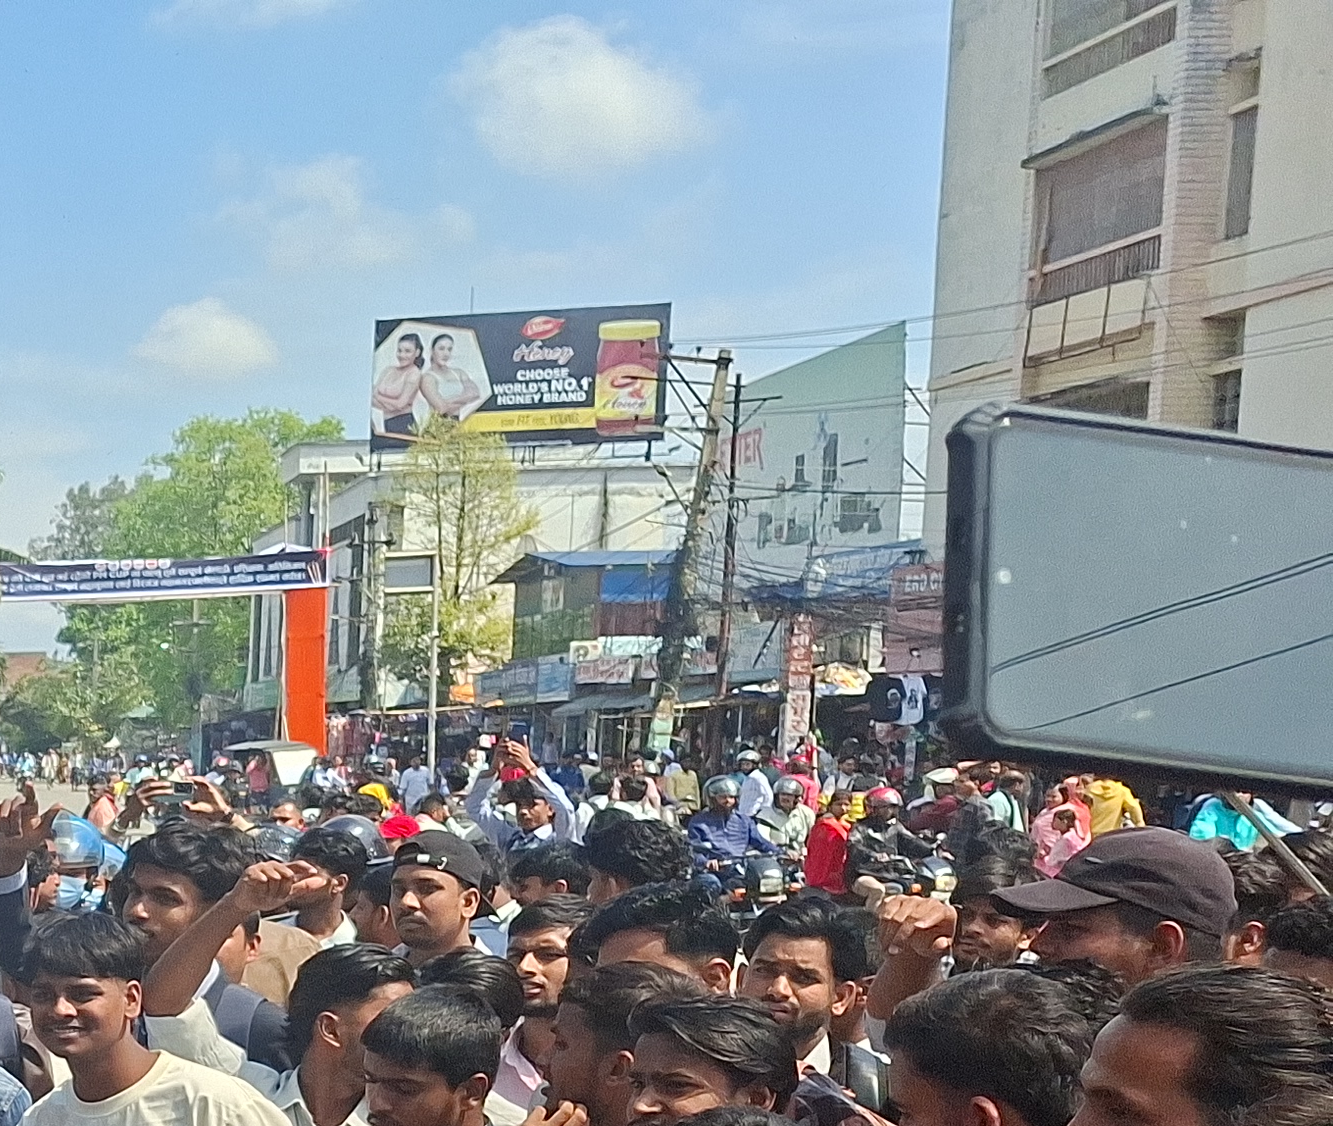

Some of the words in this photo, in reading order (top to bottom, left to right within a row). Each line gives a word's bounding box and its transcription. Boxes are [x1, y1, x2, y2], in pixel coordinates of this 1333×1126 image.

[513, 340, 574, 365] Honey
[516, 367, 570, 381] CHOOSE
[493, 381, 549, 395] WORLD'S
[497, 393, 541, 406] HONEY
[543, 390, 587, 403] BRAND
